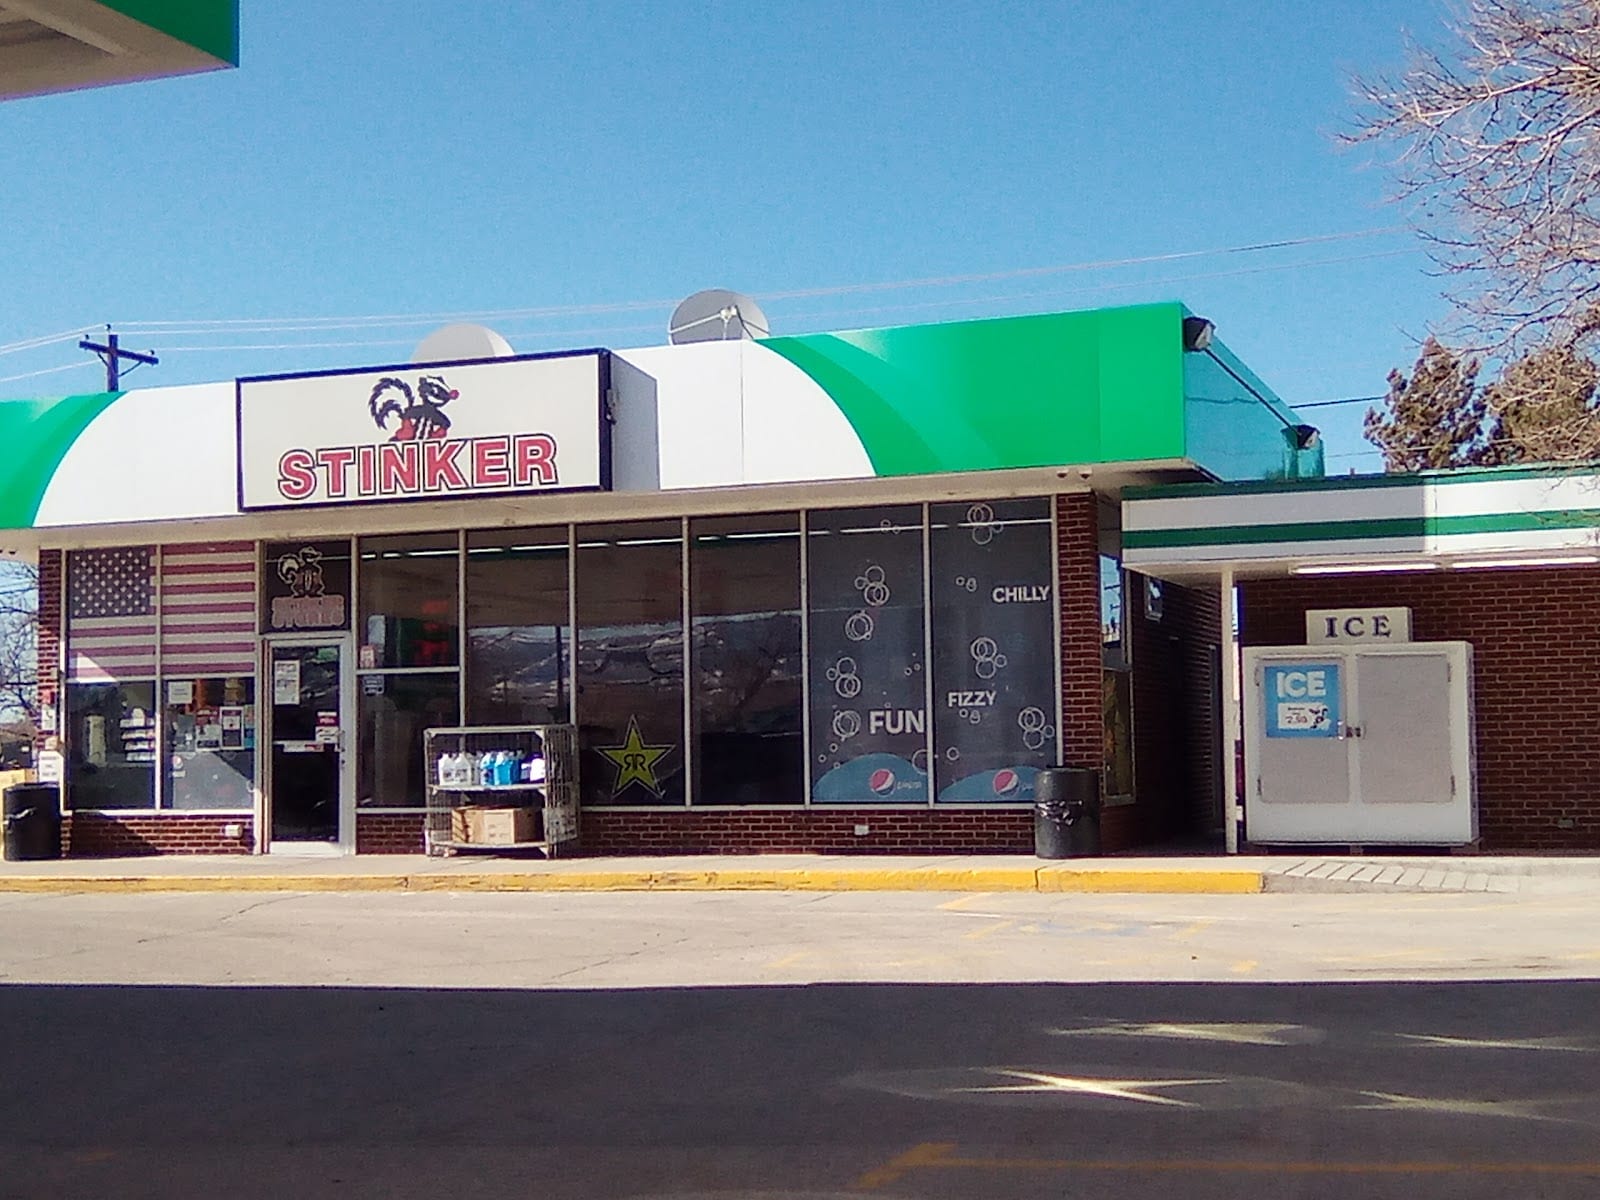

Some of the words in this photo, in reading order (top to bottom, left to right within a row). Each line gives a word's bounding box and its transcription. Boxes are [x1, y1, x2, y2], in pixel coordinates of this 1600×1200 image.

[278, 434, 559, 499] STINKER
[992, 585, 1050, 603] CHILLY
[1325, 615, 1391, 638] ICE
[1276, 671, 1326, 698] ICE
[948, 691, 996, 708] FIZZY
[870, 709, 925, 735] FUN
